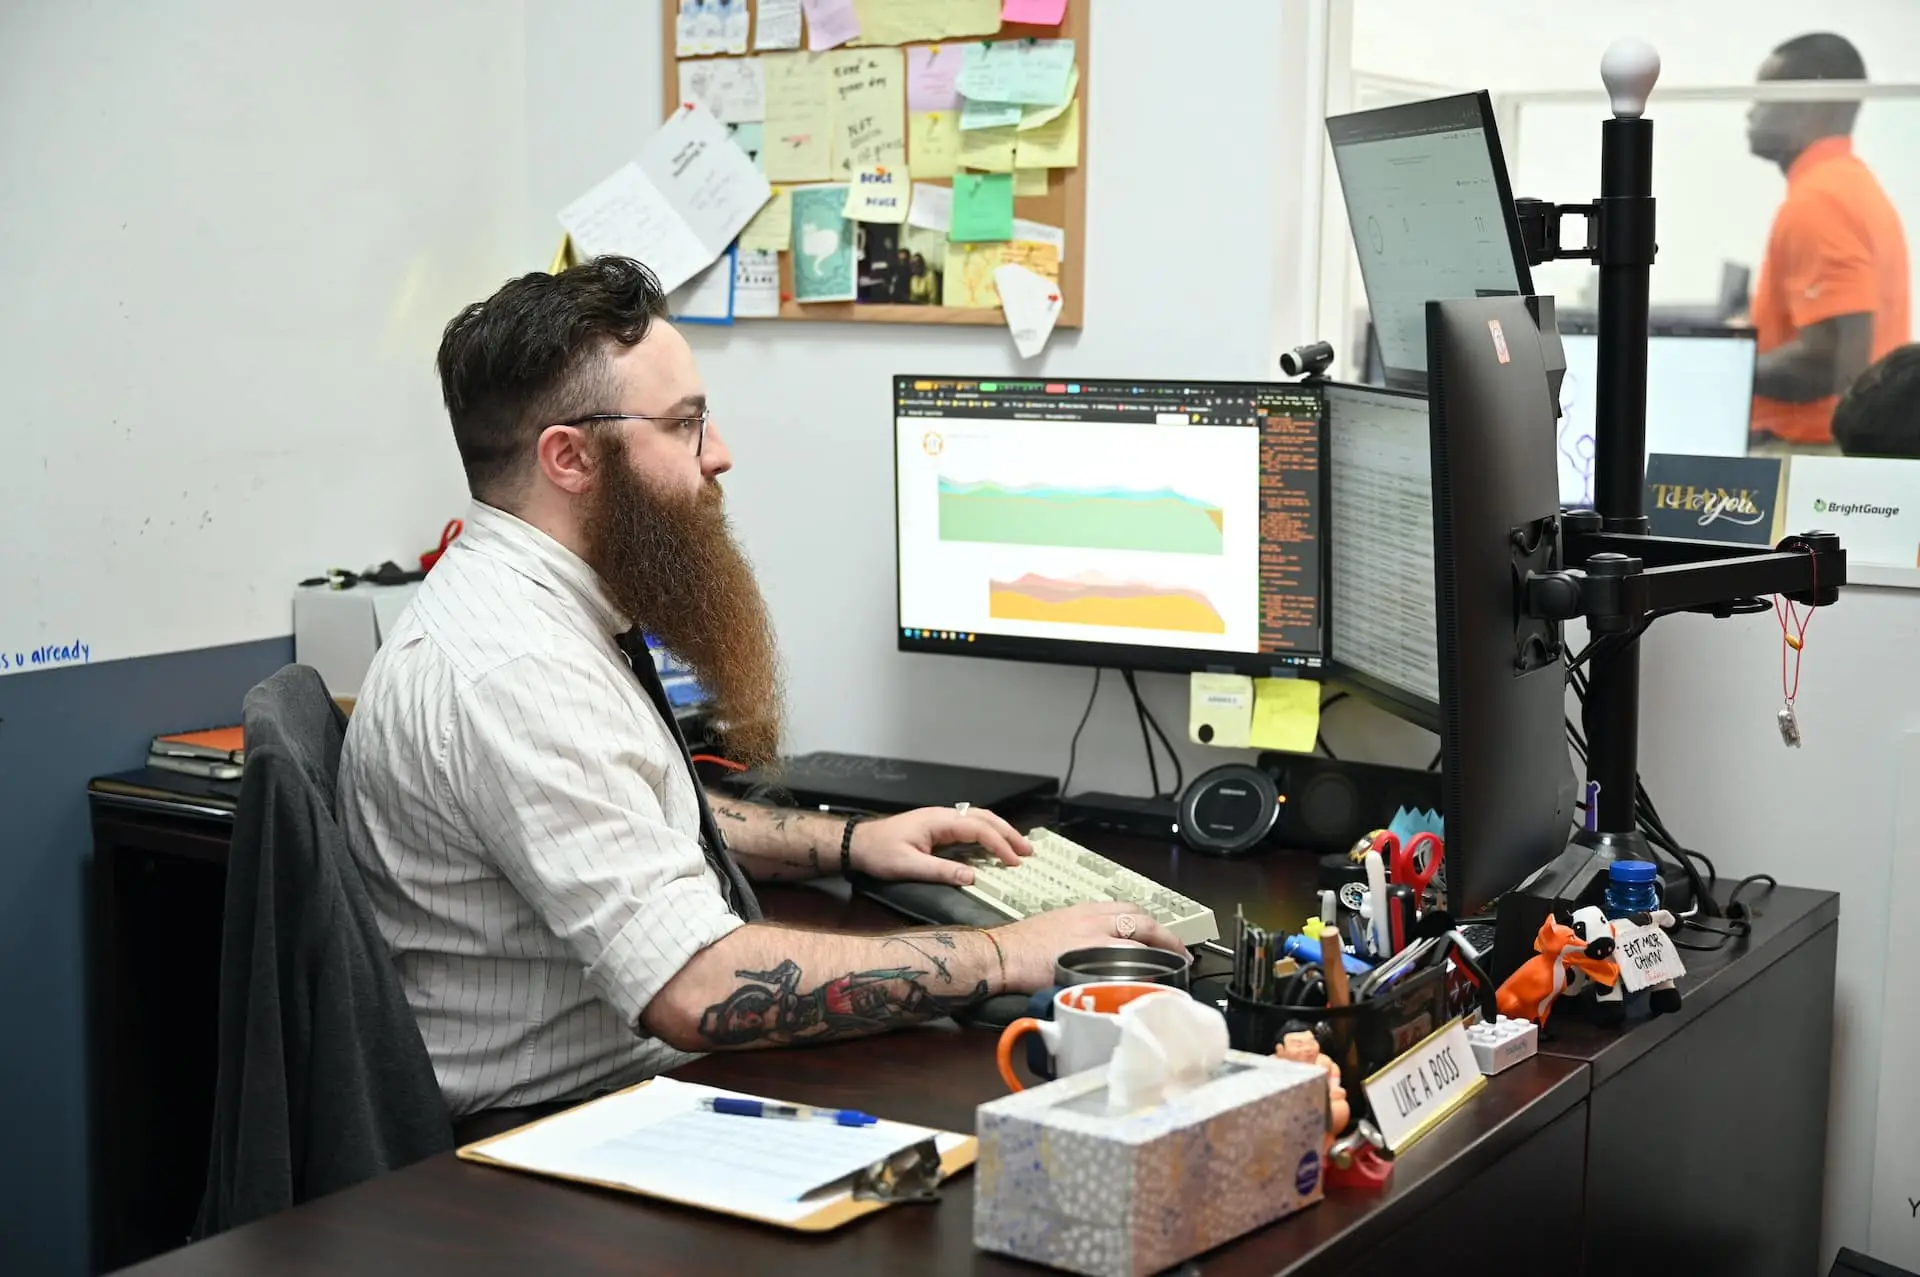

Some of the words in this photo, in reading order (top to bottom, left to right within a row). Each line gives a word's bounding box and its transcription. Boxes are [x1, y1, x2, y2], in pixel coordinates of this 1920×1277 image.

[1650, 484, 1759, 514] THANK
[1828, 502, 1900, 518] BrightGauge
[0, 653, 9, 669] s
[15, 653, 24, 667] u
[31, 639, 90, 664] already
[1623, 938, 1642, 958] EAT
[1641, 933, 1664, 949] MOR
[1391, 1074, 1422, 1118] LIKE
[1418, 1067, 1434, 1099] A
[1428, 1045, 1461, 1091] BOSS
